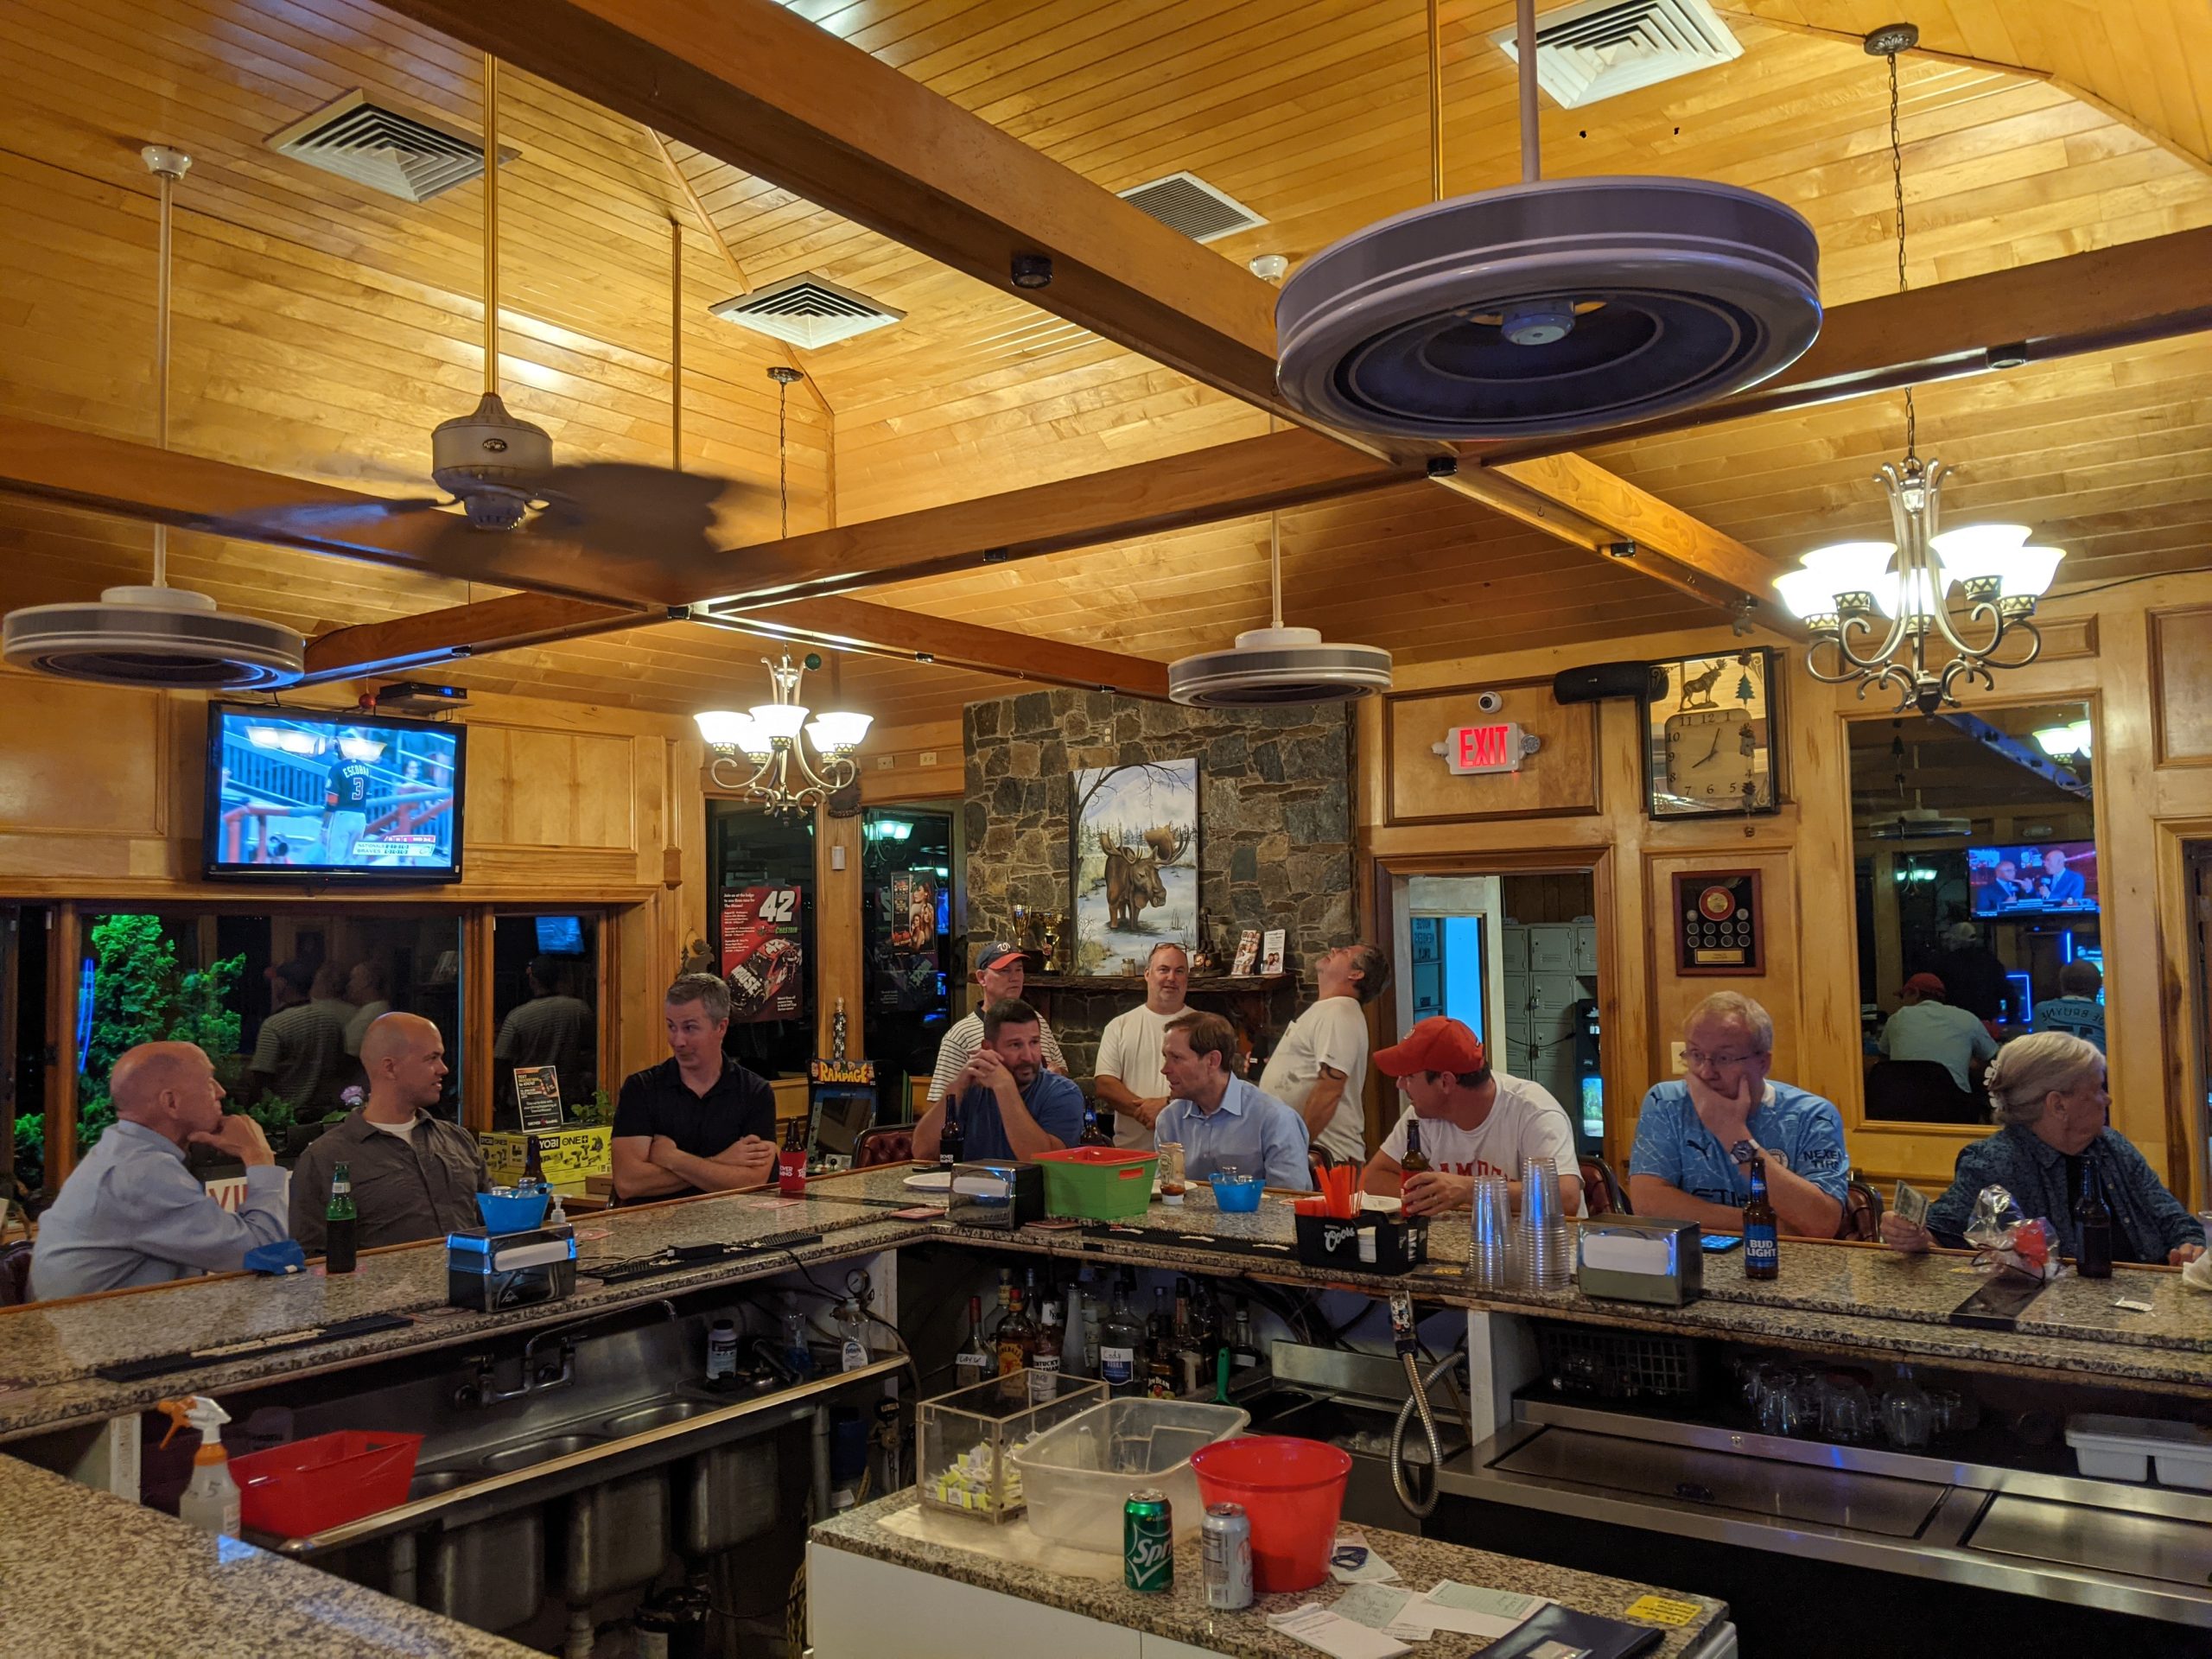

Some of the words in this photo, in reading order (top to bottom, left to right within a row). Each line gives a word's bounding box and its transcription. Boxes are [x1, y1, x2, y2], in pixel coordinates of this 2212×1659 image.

[1680, 716, 1692, 727] 11
[1700, 713, 1715, 724] 12
[1724, 712, 1732, 721] 1
[1667, 732, 1681, 743] 10
[1459, 726, 1509, 767] EXIT
[1668, 752, 1675, 762] 9
[1669, 772, 1676, 783] 8
[1745, 768, 1753, 779] 4
[352, 777, 363, 800] 3
[1685, 786, 1692, 796] 7
[1707, 784, 1714, 794] 6
[1729, 782, 1737, 792] 5
[759, 890, 795, 922] 42
[820, 1061, 868, 1084] RAMPAGE
[539, 1139, 559, 1149] YOBI
[1324, 1226, 1355, 1253] Coors
[1750, 1240, 1773, 1249] BUD
[1746, 1248, 1777, 1257] LIGHT
[1132, 1538, 1173, 1567] Spri
